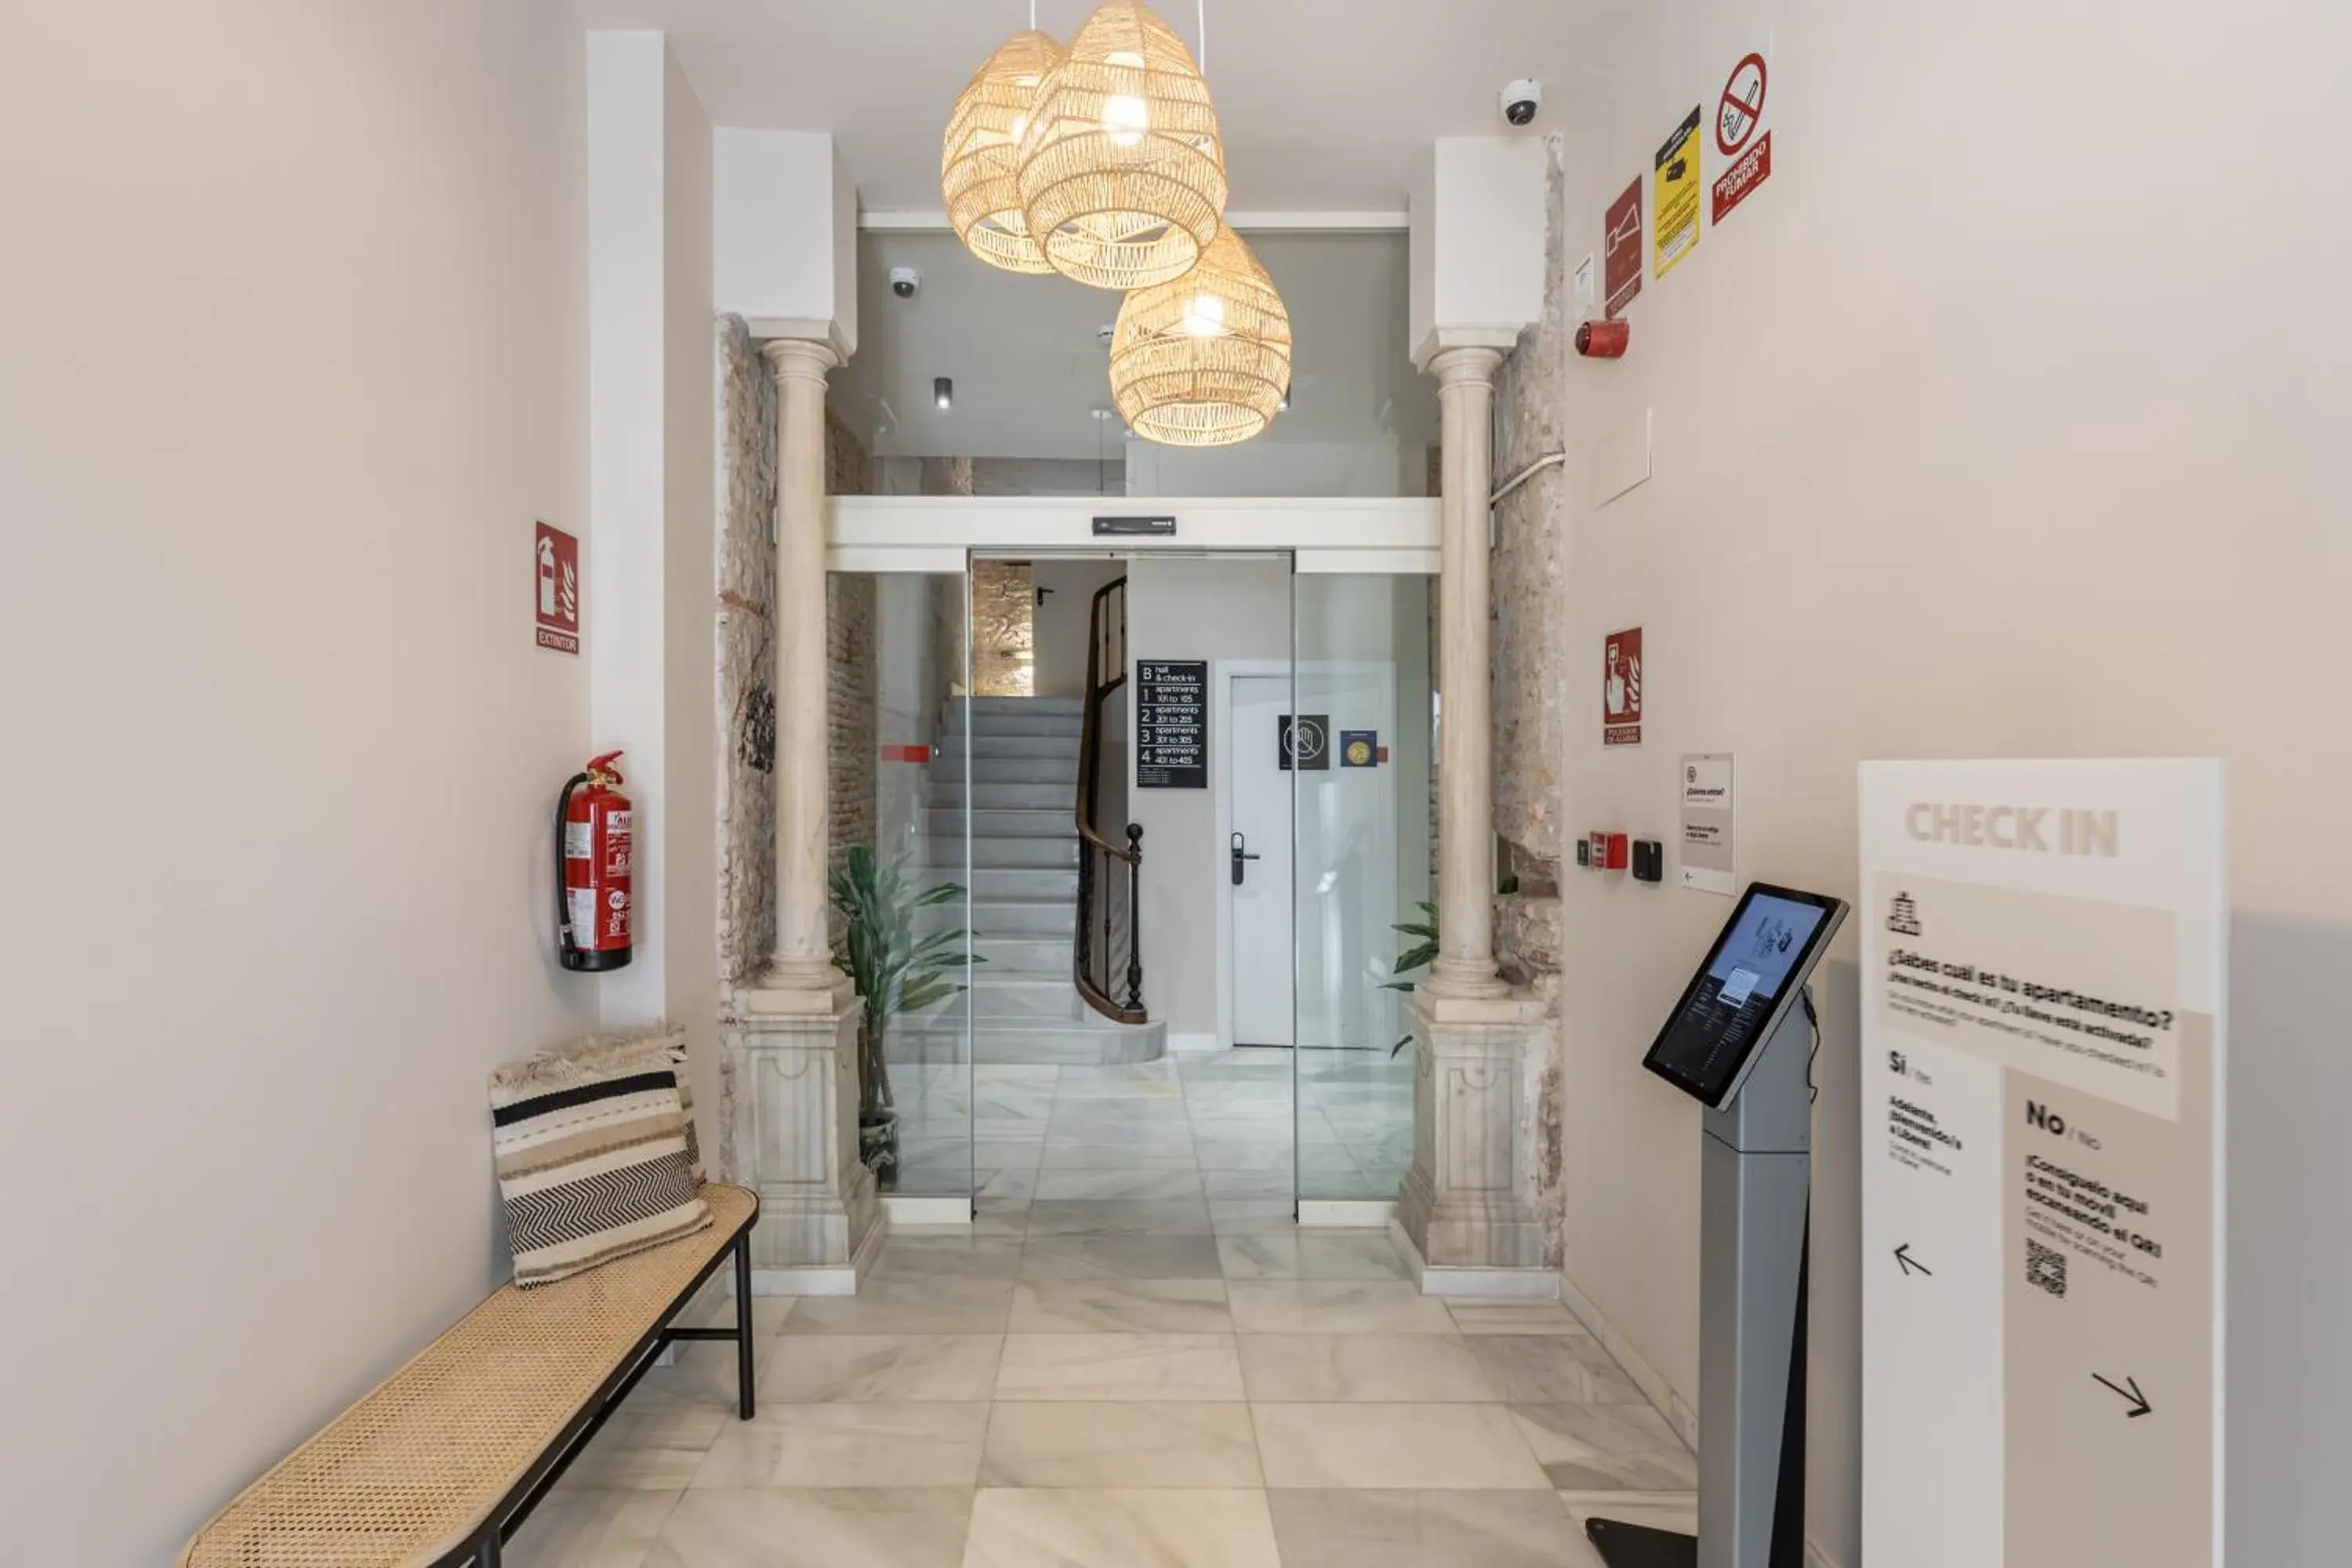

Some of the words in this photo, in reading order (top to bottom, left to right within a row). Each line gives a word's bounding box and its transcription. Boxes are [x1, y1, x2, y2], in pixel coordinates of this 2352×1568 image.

[1717, 141, 1766, 198] PROHIBIDO
[1726, 160, 1759, 201] FUMAR
[539, 631, 576, 652] EXTINTOR
[1143, 668, 1152, 681] B
[1163, 673, 1196, 682] check-in
[1143, 688, 1149, 702] 1
[1155, 686, 1199, 695] apartments
[1169, 695, 1178, 703] to
[1141, 709, 1151, 723] 2
[1169, 715, 1178, 724] to
[1141, 729, 1151, 743] 3
[1169, 735, 1178, 744] to
[1141, 750, 1151, 763] 4
[1155, 747, 1199, 756] apartments
[1169, 756, 1178, 764] to
[1905, 802, 2052, 853] CHECK
[2059, 808, 2119, 858] IN
[1978, 971, 1997, 988] es
[1999, 974, 2019, 993] tu
[2023, 982, 2174, 1031] apartamento?
[2026, 1099, 2065, 1135] No
